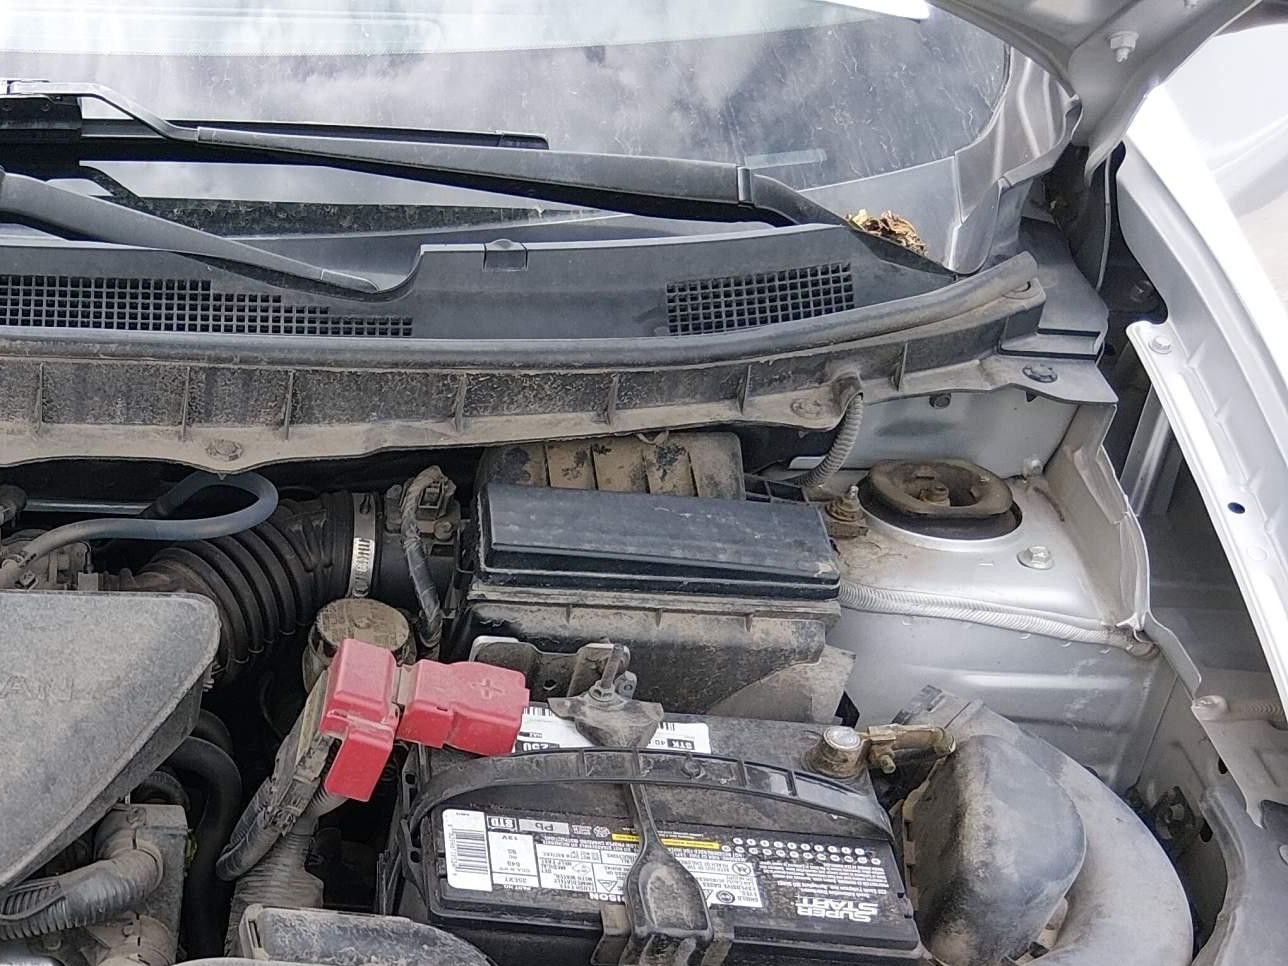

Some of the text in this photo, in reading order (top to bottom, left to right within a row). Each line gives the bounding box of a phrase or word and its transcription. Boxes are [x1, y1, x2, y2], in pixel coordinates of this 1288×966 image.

[535, 822, 554, 831] Pb
[794, 896, 879, 915] START
[796, 906, 872, 923] SUPER
